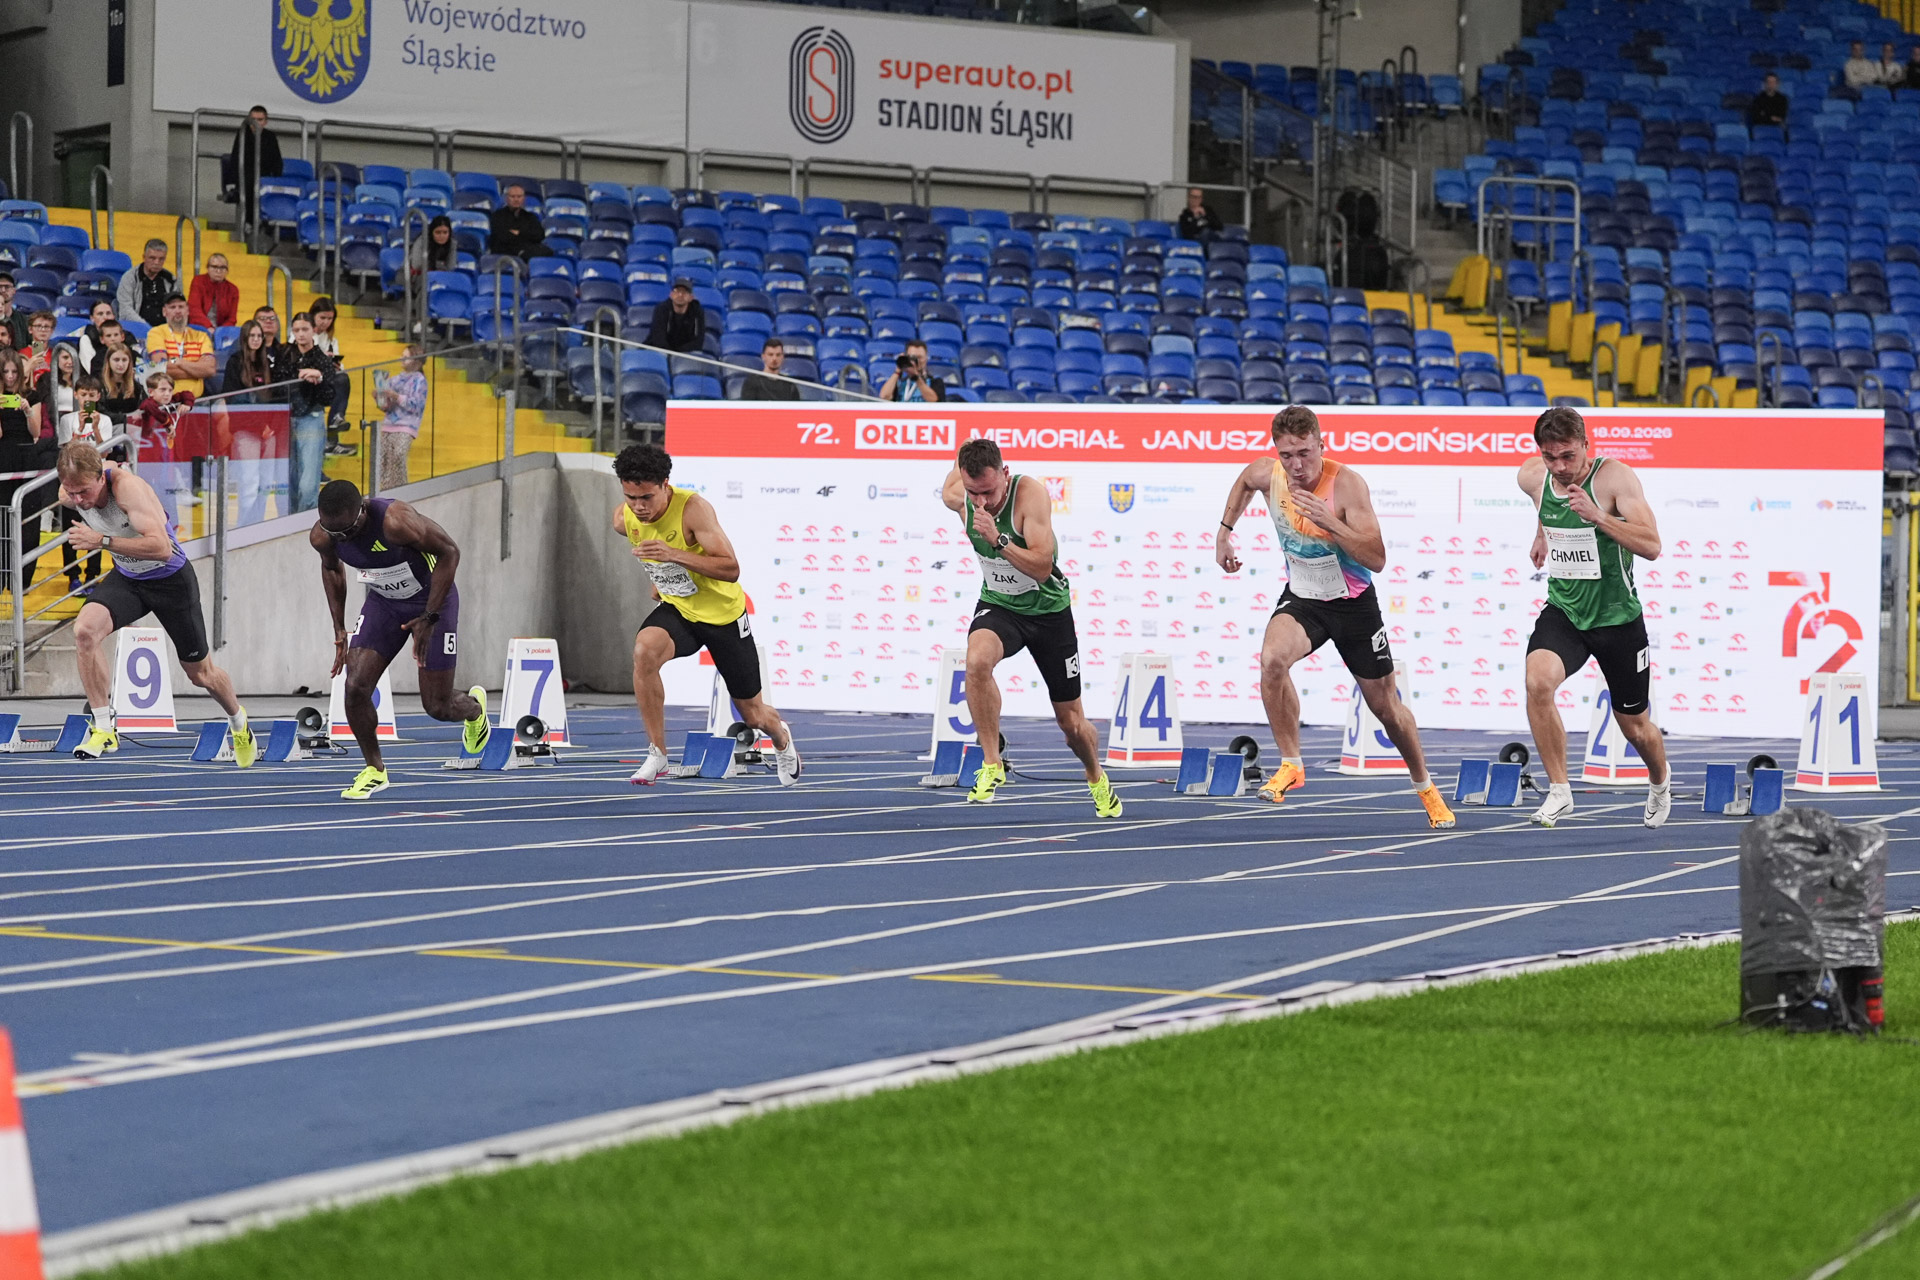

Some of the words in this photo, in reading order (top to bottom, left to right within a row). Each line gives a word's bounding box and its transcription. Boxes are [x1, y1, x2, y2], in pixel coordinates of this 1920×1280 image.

[403, 0, 587, 39] Województwo
[401, 34, 497, 75] Śląskie
[878, 58, 1074, 100] superauto.pl
[878, 98, 983, 134] STADION
[989, 101, 1073, 148] ŚLĄSKI
[797, 422, 841, 445] 72.
[861, 424, 950, 446] ORLEN
[1592, 426, 1673, 439] 18.09.2026
[776, 487, 800, 495] SPORT
[1551, 548, 1595, 563] CHMIEL
[991, 570, 1019, 584] ŻAK
[447, 634, 455, 653] 5
[1641, 649, 1647, 667] 1
[126, 647, 162, 709] 9
[1070, 657, 1078, 675] 3
[520, 659, 554, 718] 7
[947, 670, 977, 736] 5
[1114, 674, 1130, 741] 4
[1139, 675, 1173, 742] 4
[1591, 688, 1612, 758] 2
[1809, 695, 1823, 765] 1
[1838, 695, 1861, 766] 1
